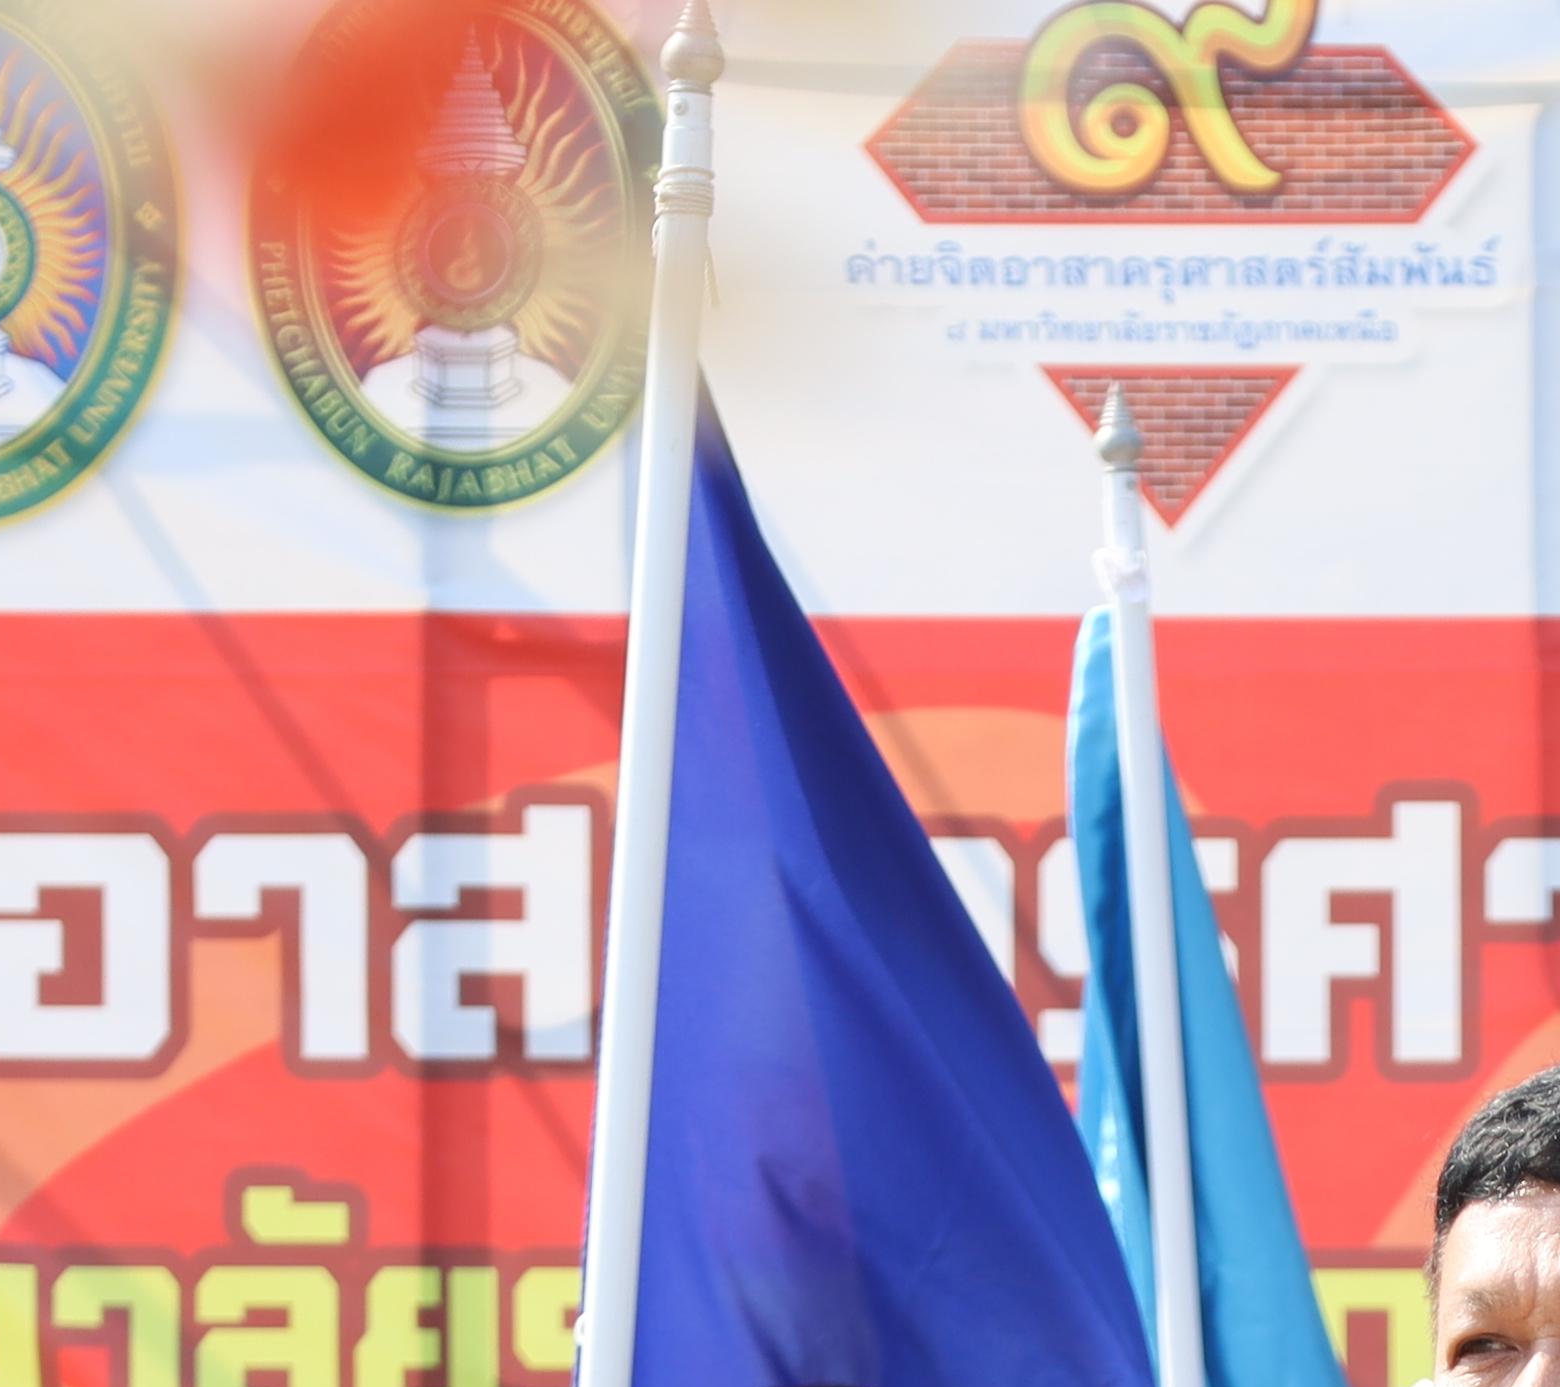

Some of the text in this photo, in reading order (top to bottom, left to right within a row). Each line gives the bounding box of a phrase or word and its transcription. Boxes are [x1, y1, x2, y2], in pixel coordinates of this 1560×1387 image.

[69, 254, 167, 448] UNIVERSITY
[260, 241, 579, 503] PHETCHABUN RAJABHAT
